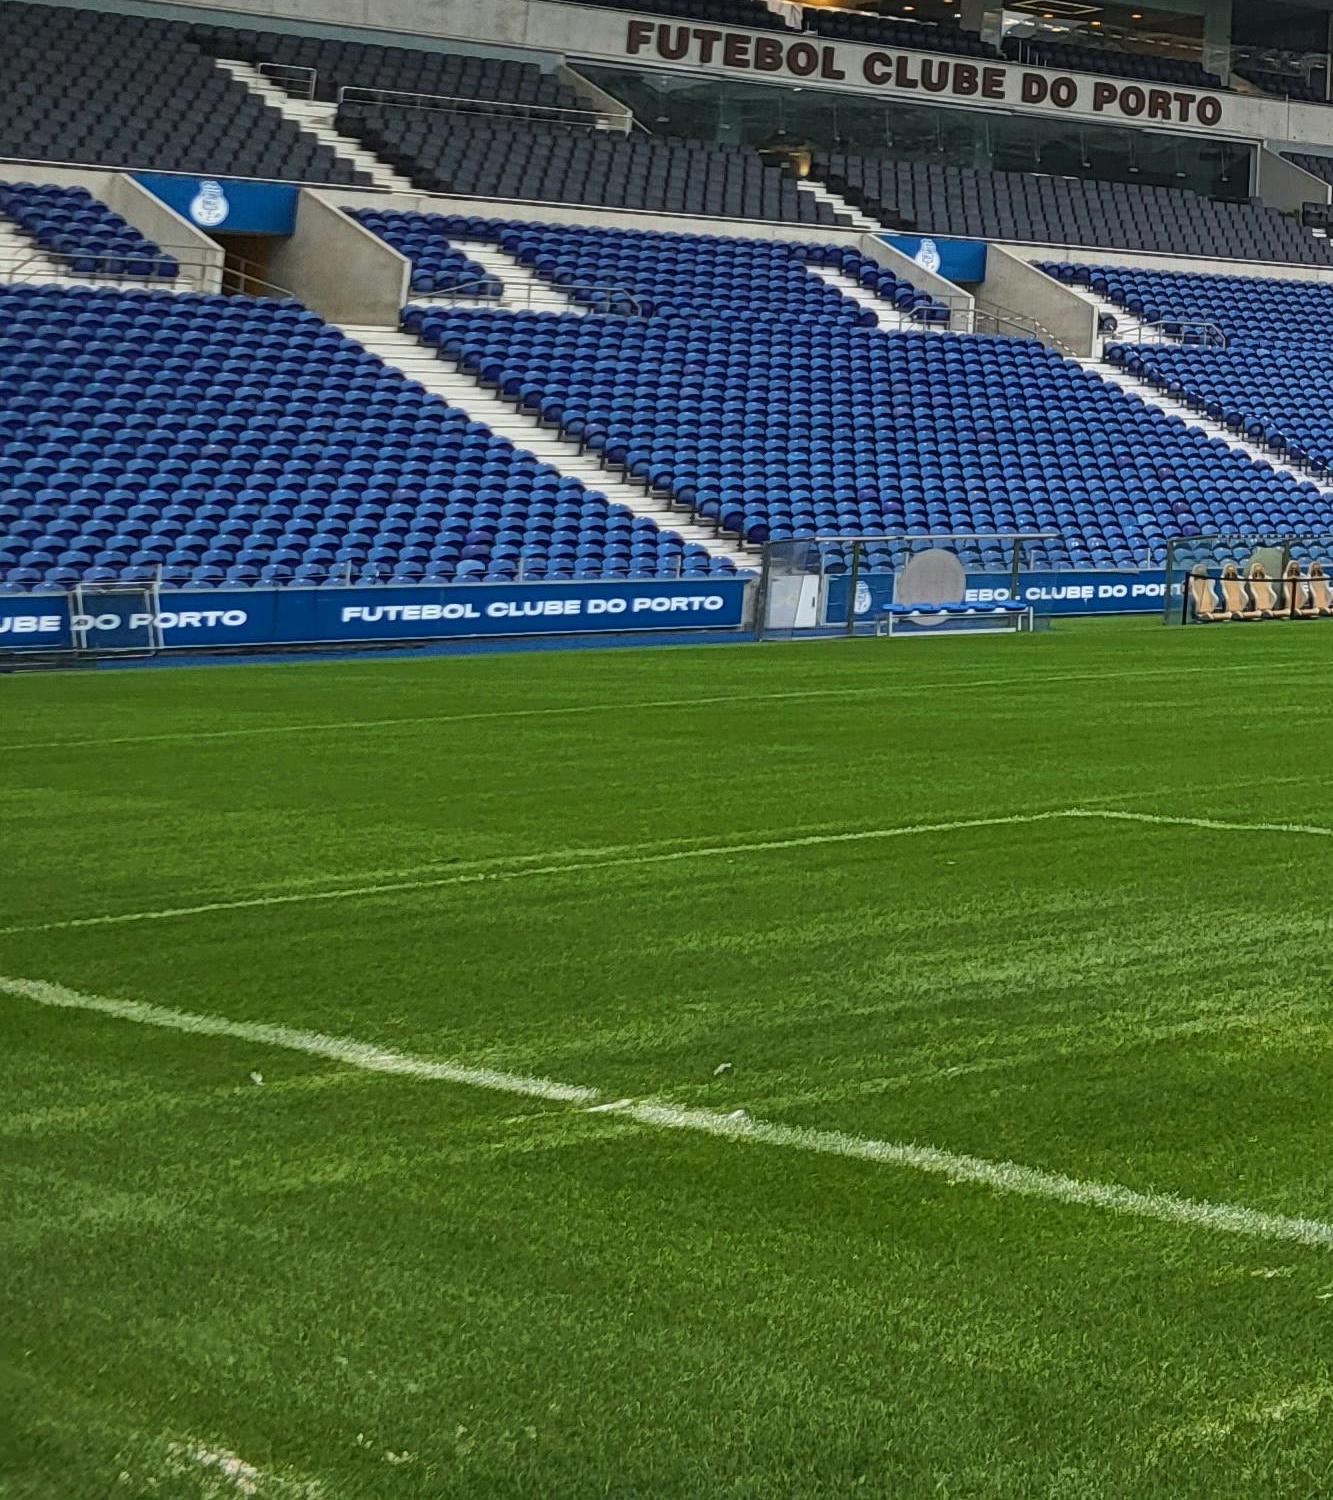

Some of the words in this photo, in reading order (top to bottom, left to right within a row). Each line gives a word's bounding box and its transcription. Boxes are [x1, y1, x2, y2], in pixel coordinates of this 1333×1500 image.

[626, 19, 846, 80] FUTEBOL
[863, 51, 1007, 100] CLUBE
[1021, 72, 1079, 108] DO
[1093, 82, 1223, 126] PORTO
[1025, 584, 1094, 601] CLUBE
[1098, 584, 1128, 598] DO
[70, 613, 122, 631] DO
[129, 609, 248, 630] PORTO
[341, 603, 481, 623] FUTEBOL
[486, 598, 581, 618] CLUBE
[587, 597, 627, 615] DO
[632, 595, 724, 613] PORTO
